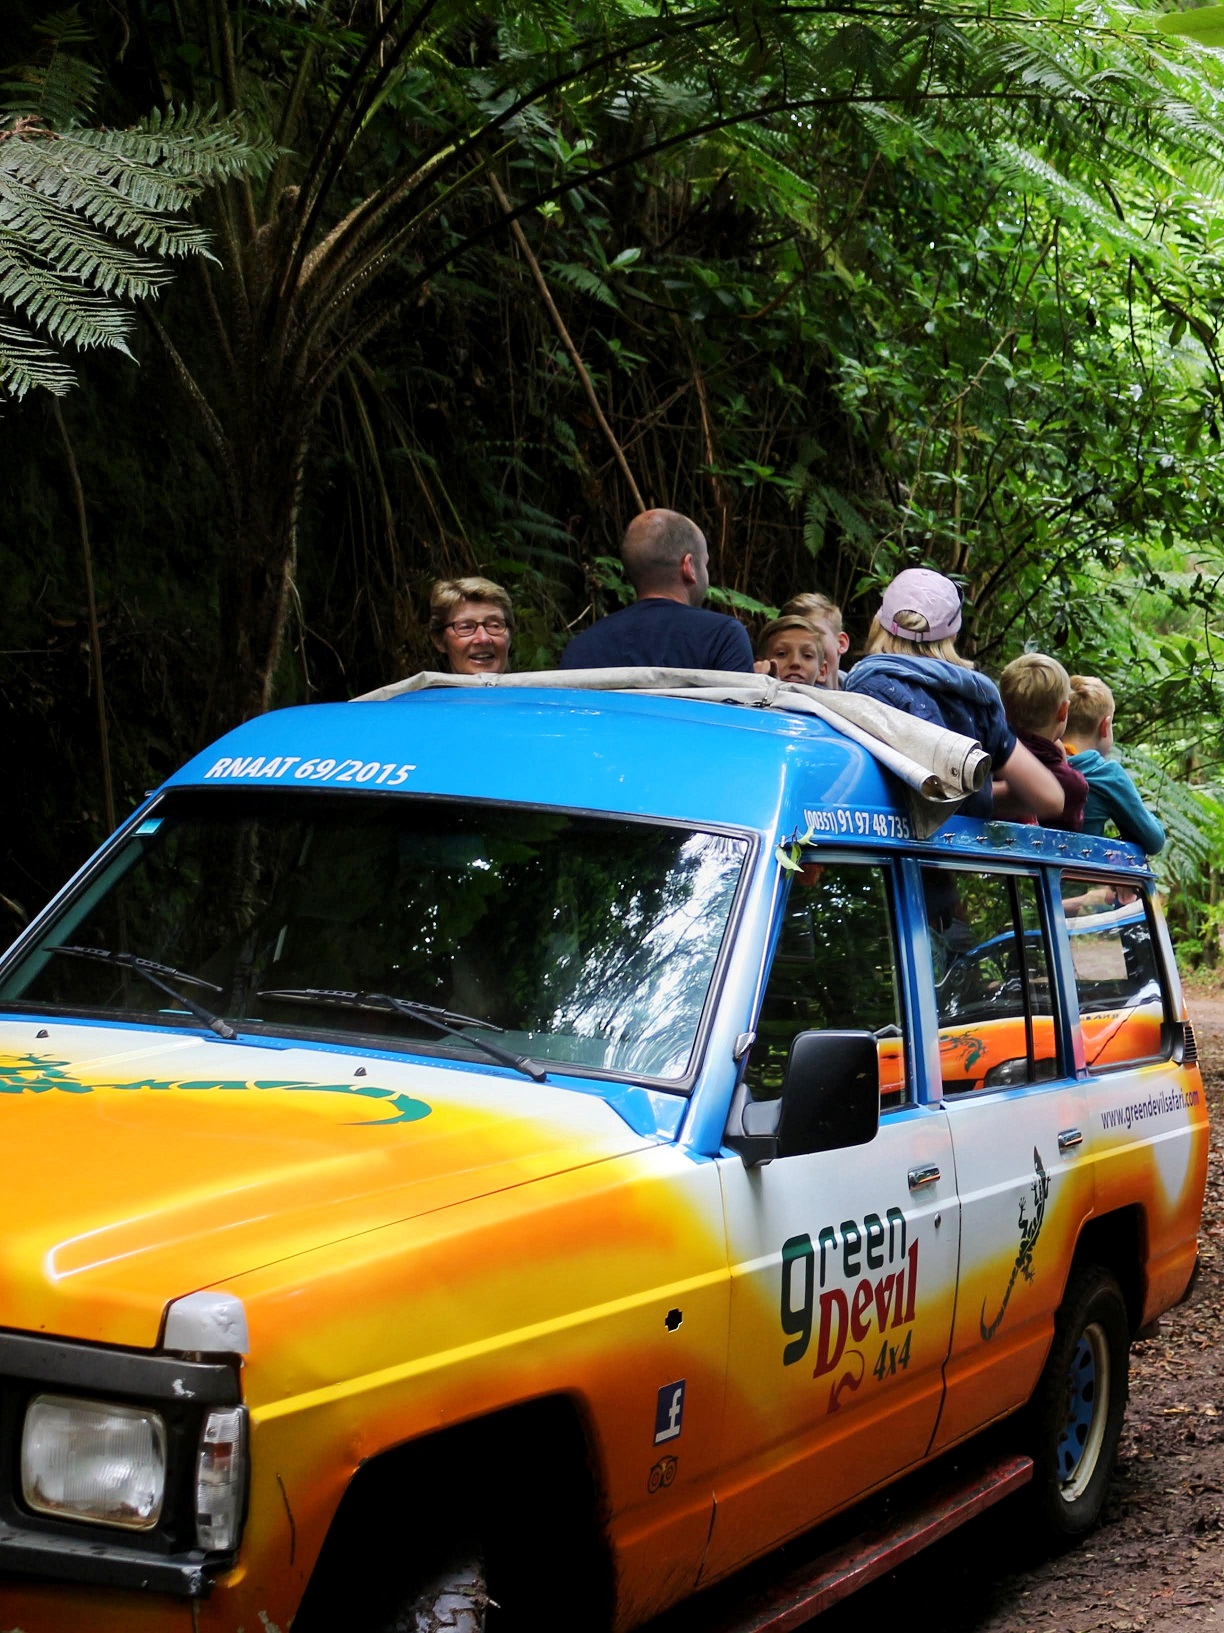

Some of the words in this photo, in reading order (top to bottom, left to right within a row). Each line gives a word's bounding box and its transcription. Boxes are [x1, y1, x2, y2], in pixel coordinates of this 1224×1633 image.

[204, 757, 300, 779] RNAAT
[294, 758, 416, 785] 69/2015
[804, 809, 838, 835] (00351)
[837, 809, 854, 833] 91
[855, 811, 869, 835] 97
[873, 813, 888, 837] 48
[888, 815, 910, 839] 735
[1101, 1088, 1200, 1129] www.greendevilsafari.com
[780, 1206, 906, 1367] green
[813, 1237, 919, 1380] Devil
[873, 1329, 912, 1382] 4x4
